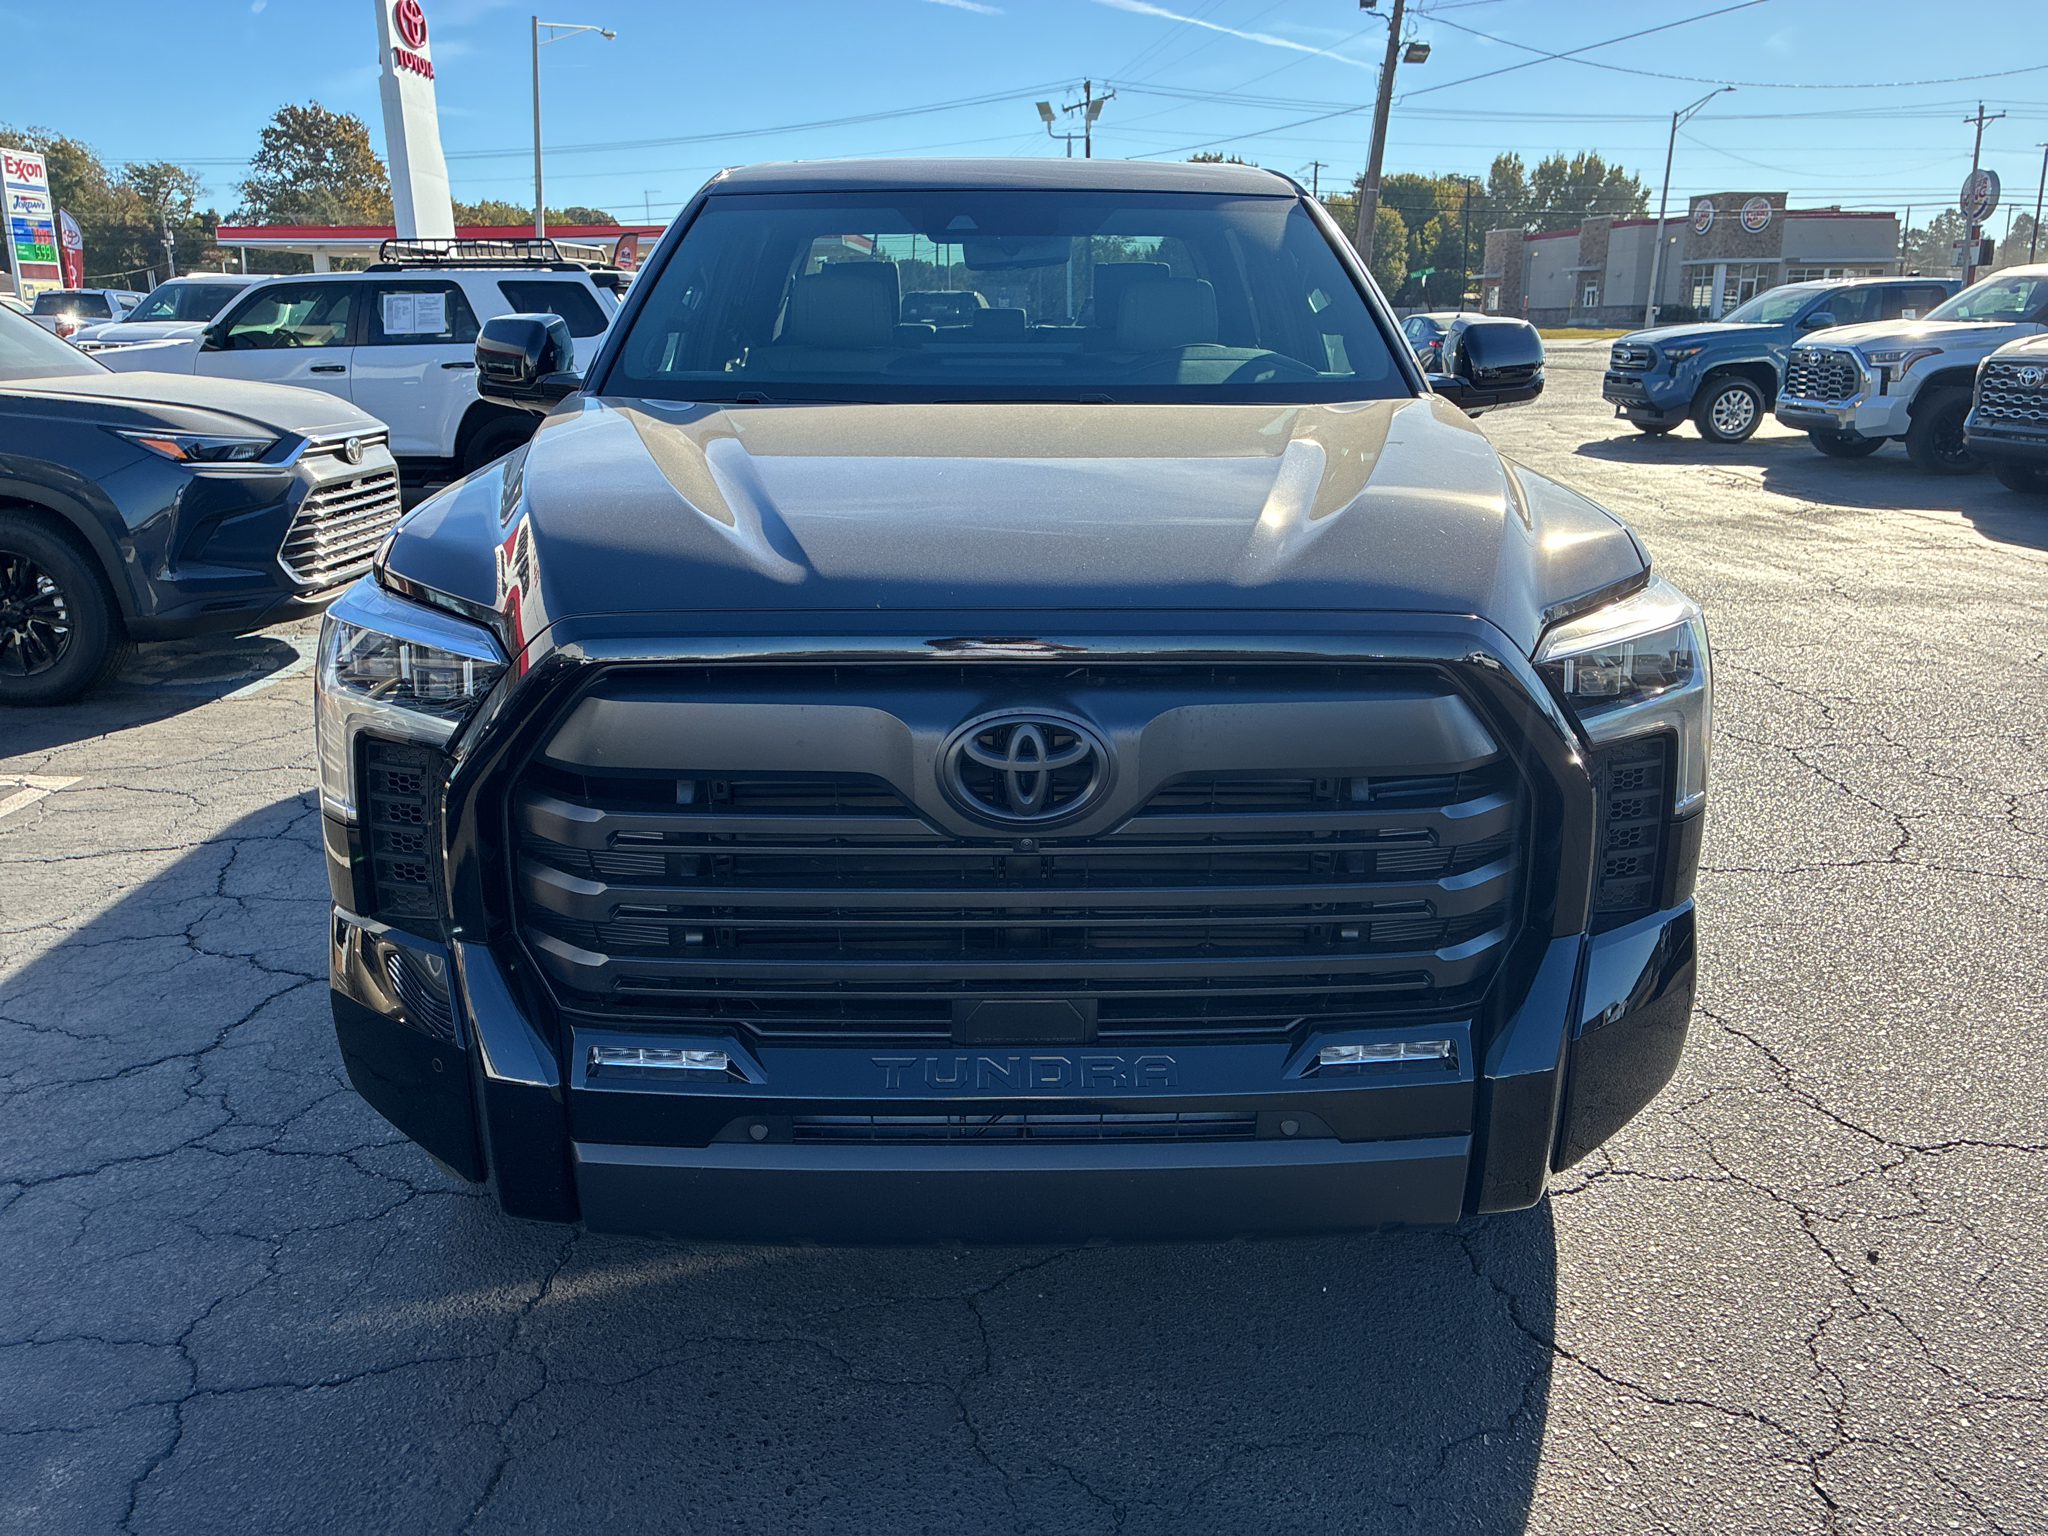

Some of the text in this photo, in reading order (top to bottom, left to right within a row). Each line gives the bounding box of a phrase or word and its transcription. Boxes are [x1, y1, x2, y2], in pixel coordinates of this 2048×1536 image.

[393, 47, 435, 79] TOYOTA
[4, 155, 43, 183] Exxon
[871, 1055, 1179, 1090] TUNDRA
